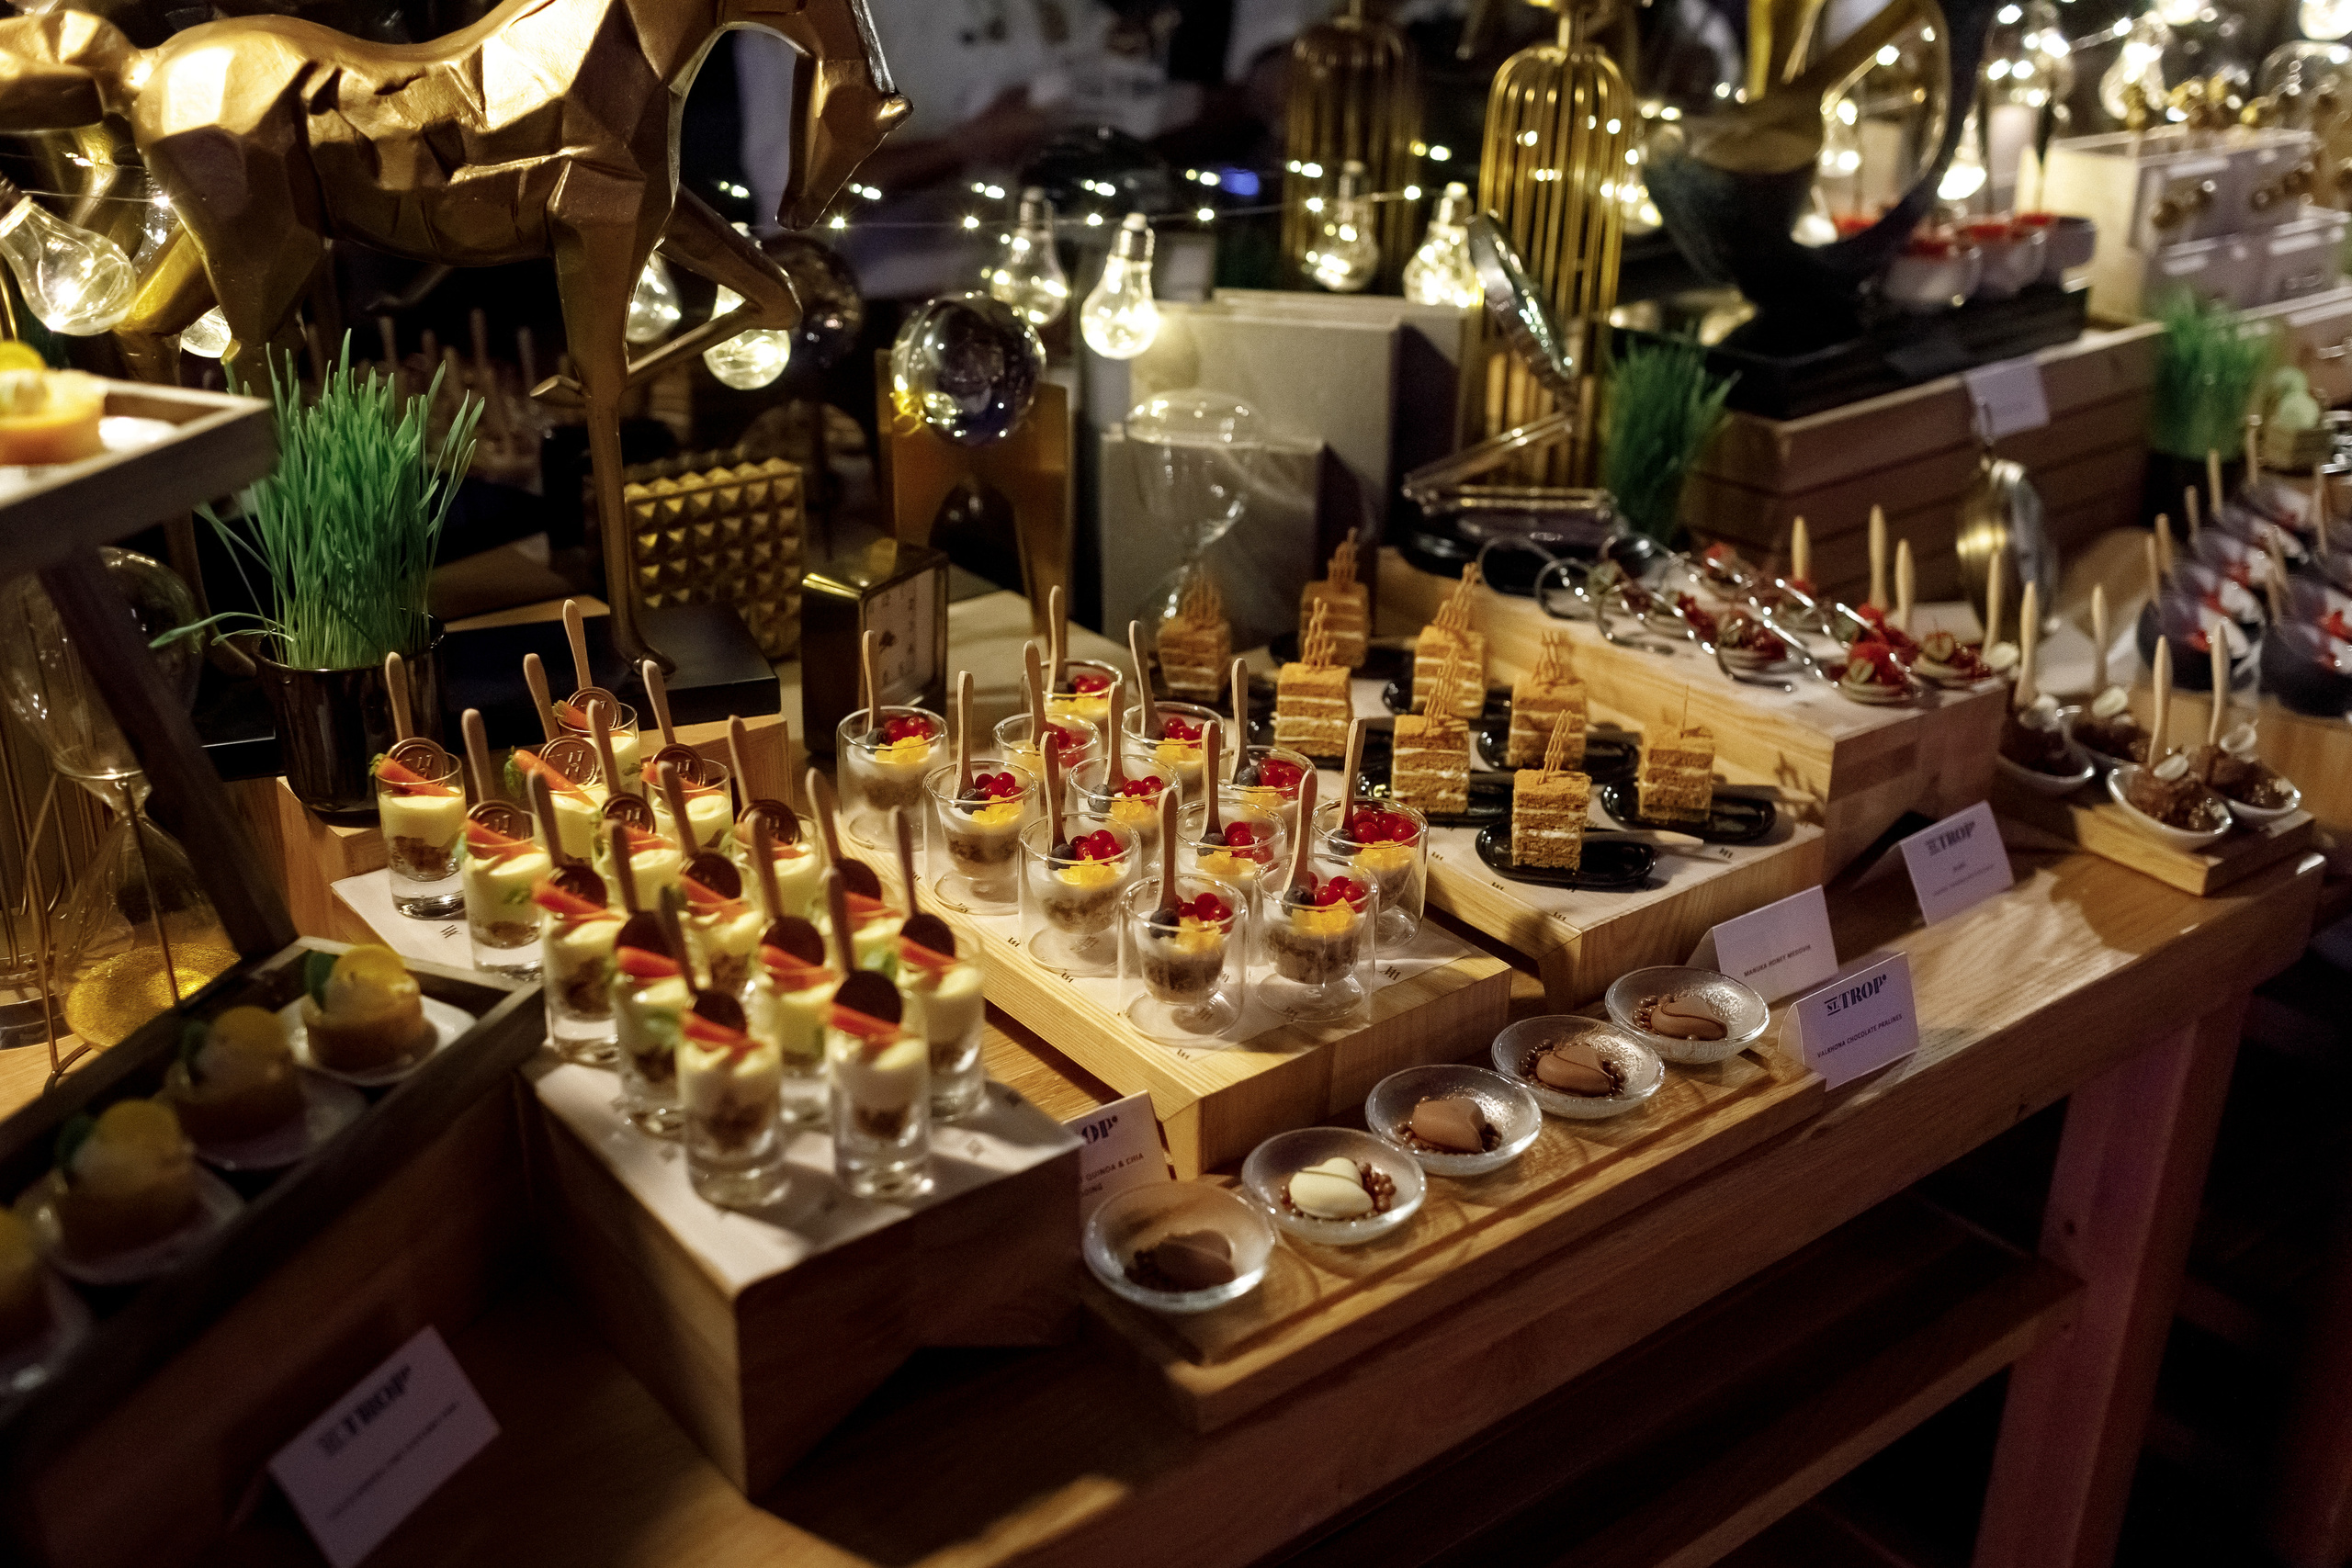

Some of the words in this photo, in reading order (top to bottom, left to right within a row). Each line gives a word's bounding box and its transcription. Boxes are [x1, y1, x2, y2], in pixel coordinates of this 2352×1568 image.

[1744, 963, 1768, 977] MANUKA
[1816, 1040, 1846, 1058] VALRHONA
[1847, 1024, 1877, 1044] CHOCOLATE
[1878, 1013, 1903, 1029] PRALINES
[1086, 1164, 1116, 1180] QUINOA
[1125, 1152, 1144, 1165] CHIA
